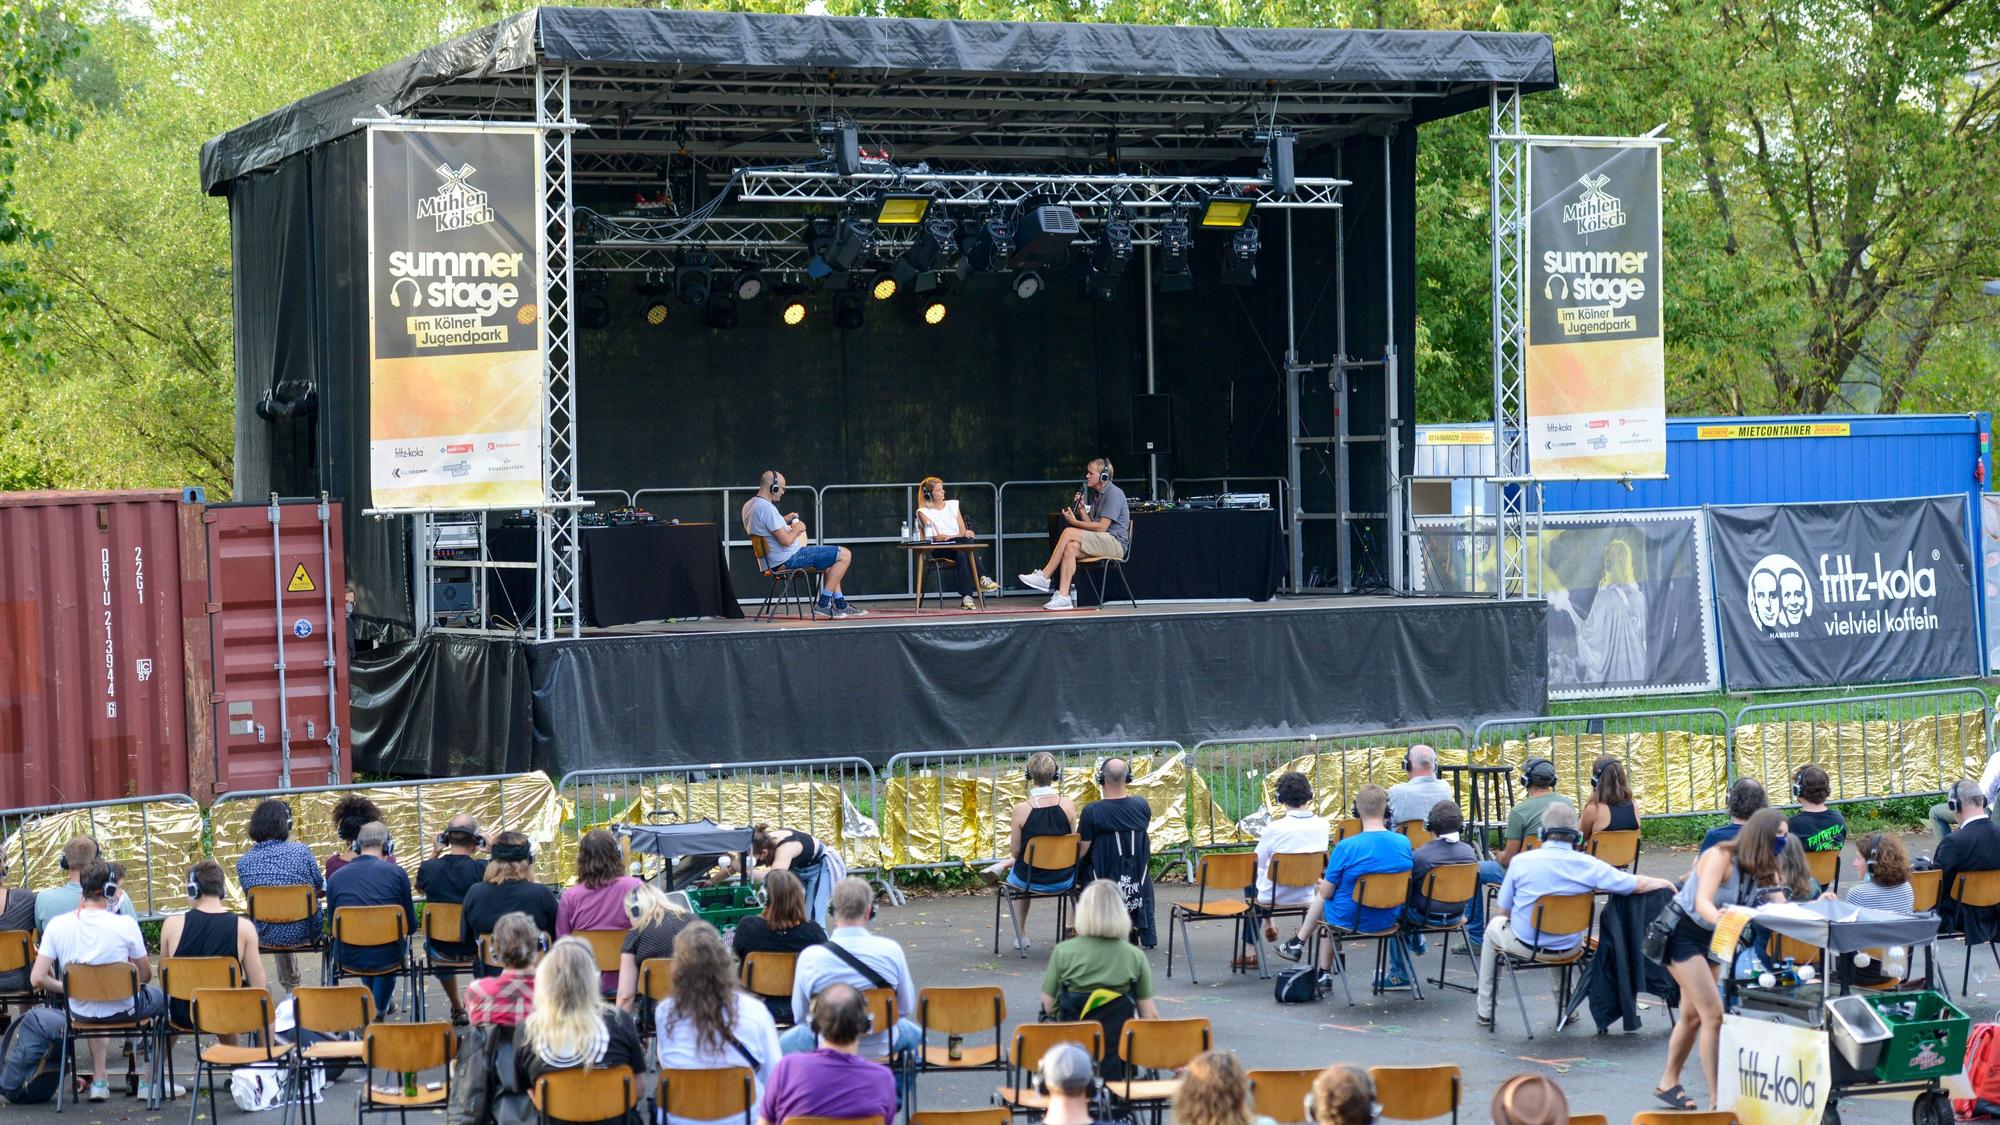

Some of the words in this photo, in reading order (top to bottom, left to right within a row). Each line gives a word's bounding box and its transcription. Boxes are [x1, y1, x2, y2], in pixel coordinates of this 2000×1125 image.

[417, 191, 487, 219] Mühlen
[1562, 199, 1620, 223] Mühlen
[436, 207, 494, 232] Kölsch
[1577, 211, 1626, 234] Kölsch
[389, 251, 523, 277] summer
[1544, 250, 1648, 273] summer
[427, 275, 519, 317] stage
[1573, 272, 1645, 308] stage
[414, 319, 430, 331] im
[435, 316, 476, 330] Kölner
[1562, 310, 1575, 320] im
[1578, 308, 1610, 319] Kölner
[421, 328, 502, 346] Jugendpark
[1567, 318, 1631, 335] Jugendpark
[1738, 425, 1811, 437] MIETCONTAINER
[101, 548, 111, 606] DRYU
[134, 546, 144, 605] 22G1
[1824, 609, 1881, 637] vielviel
[1885, 606, 1939, 632] koffein
[1769, 631, 1800, 639] HAMBURG
[104, 611, 115, 697] 213944
[107, 702, 116, 717] 6
[1738, 1046, 1816, 1111] fritz-kola
